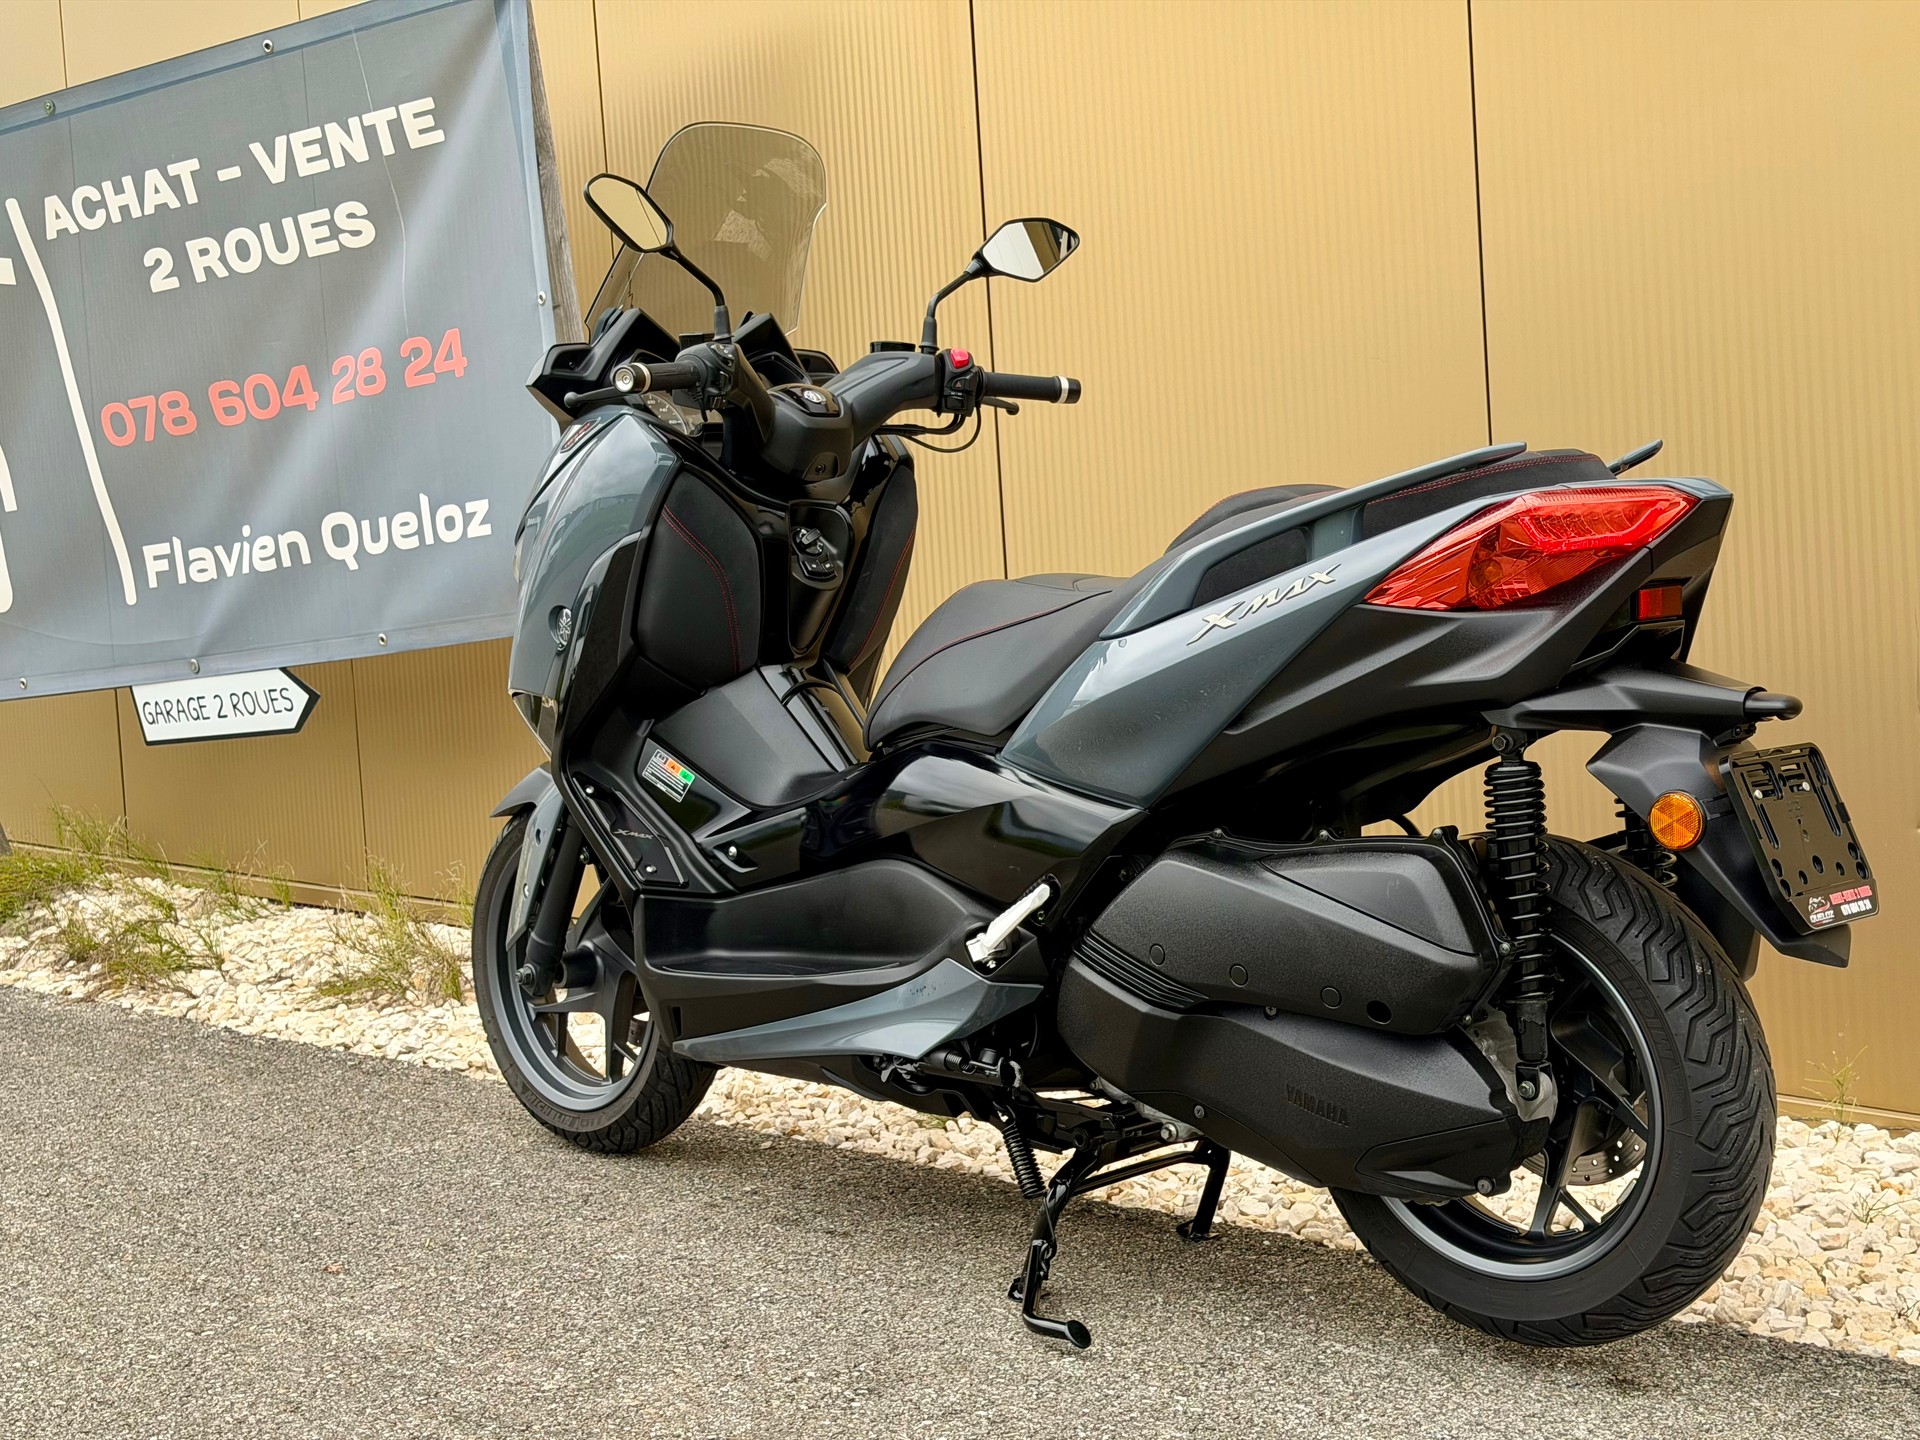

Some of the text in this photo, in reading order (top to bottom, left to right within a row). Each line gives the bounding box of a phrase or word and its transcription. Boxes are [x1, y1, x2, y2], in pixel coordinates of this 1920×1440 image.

[44, 96, 446, 241] ACHAT - VENTE
[143, 200, 376, 293] 2 ROUES
[101, 328, 468, 447] 078 604 28 24
[142, 492, 492, 589] Flavien Queloz
[1186, 563, 1341, 646] XMAX
[142, 687, 294, 725] GARAGE 2 ROUES
[524, 1090, 574, 1127] MICHELIN
[1286, 1083, 1349, 1128] YAMAHA
